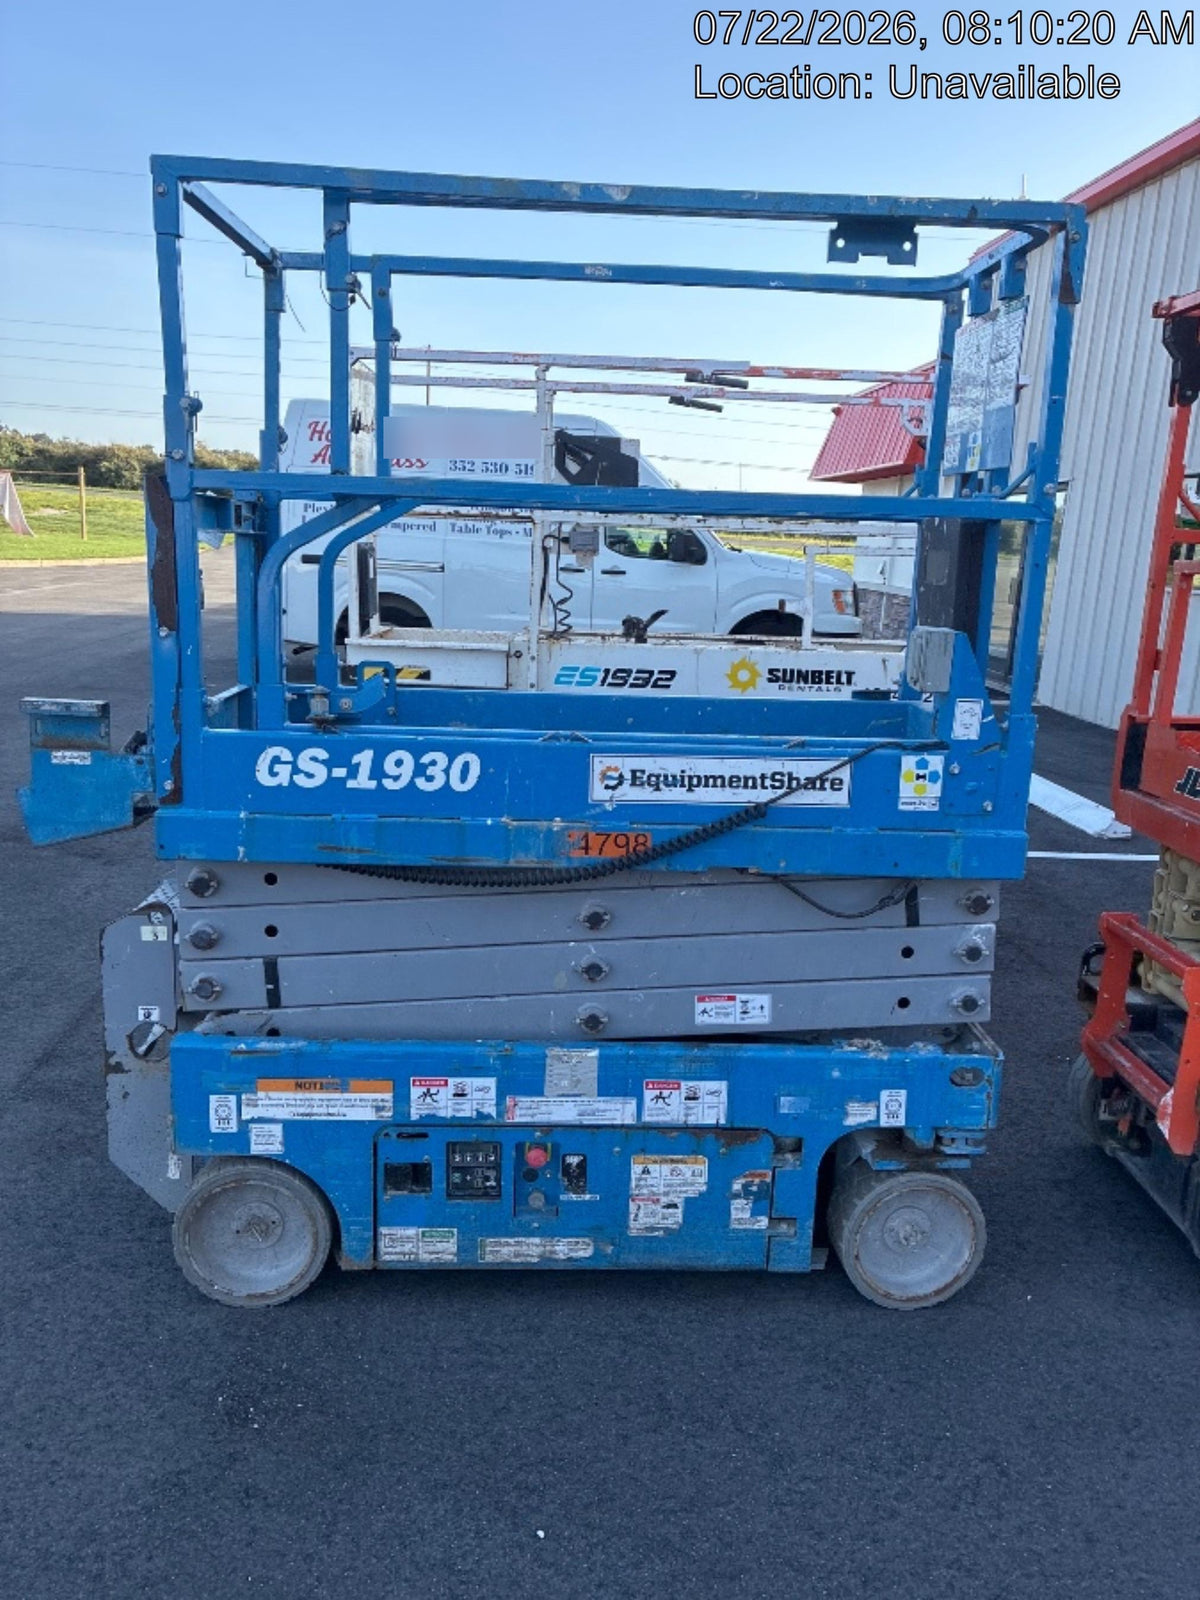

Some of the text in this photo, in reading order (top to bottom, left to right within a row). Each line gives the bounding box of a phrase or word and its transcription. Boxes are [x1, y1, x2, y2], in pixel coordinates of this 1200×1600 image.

[311, 444, 331, 464] A
[449, 460, 475, 472] 352
[481, 461, 509, 474] 530
[449, 522, 482, 534] Table
[485, 525, 512, 539] Tops
[554, 666, 678, 689] ES1932
[766, 667, 854, 686] SUNBELT
[255, 746, 481, 792] GS-1930
[630, 769, 843, 792] EquipmentShare
[294, 1081, 340, 1092] NOTI
